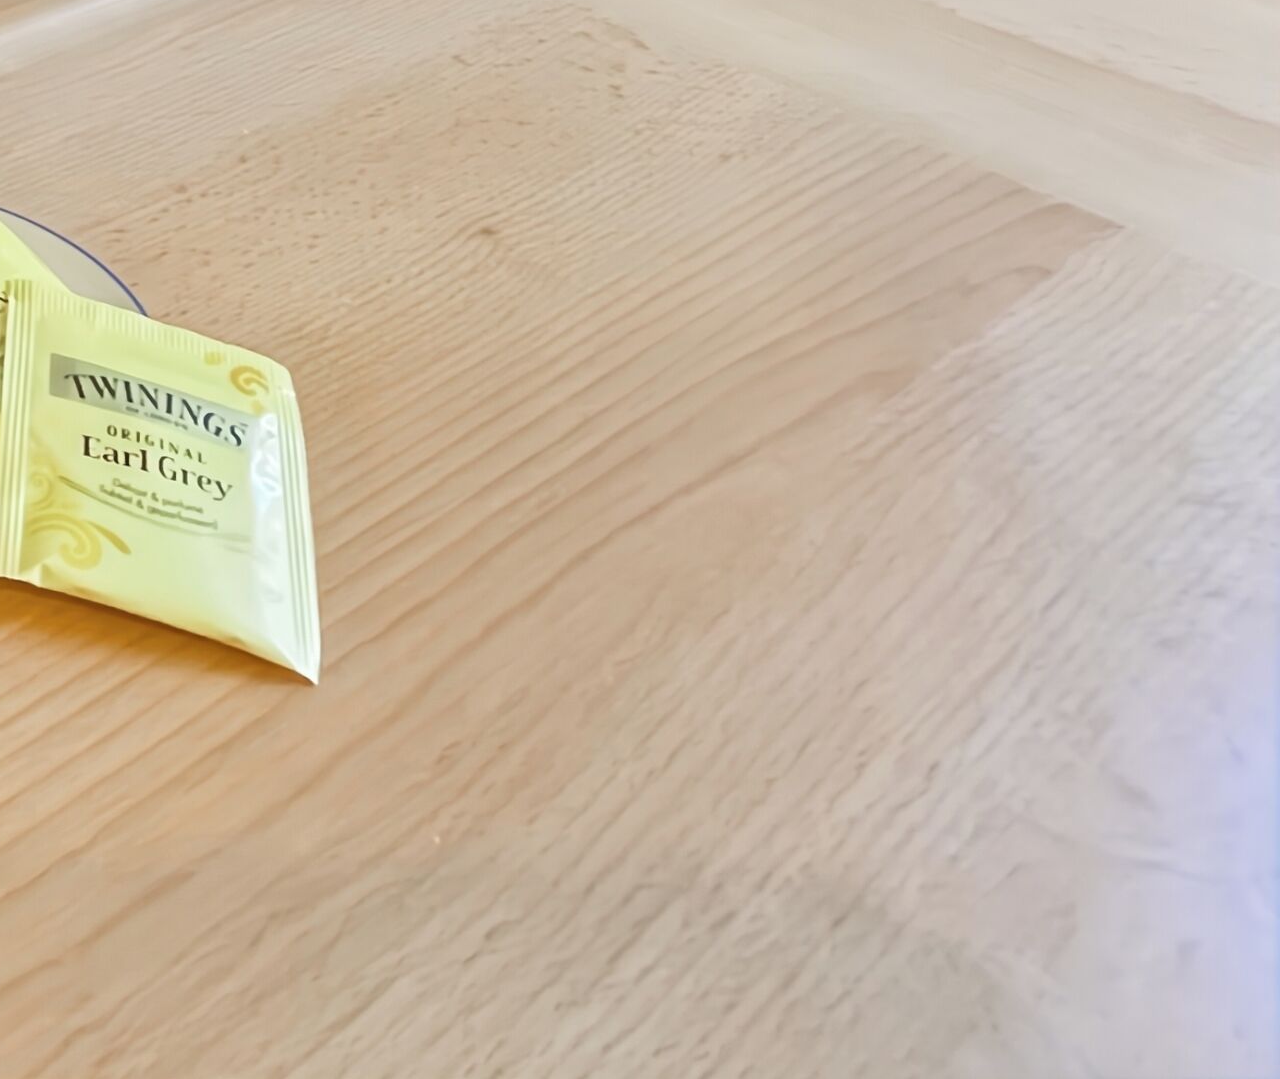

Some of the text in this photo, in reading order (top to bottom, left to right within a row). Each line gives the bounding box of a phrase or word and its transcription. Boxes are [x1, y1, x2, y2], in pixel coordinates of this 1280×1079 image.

[64, 373, 247, 447] TWININGS
[81, 434, 150, 472] Earl
[158, 455, 233, 502] Grey
[106, 424, 208, 465] ORIGINAL
